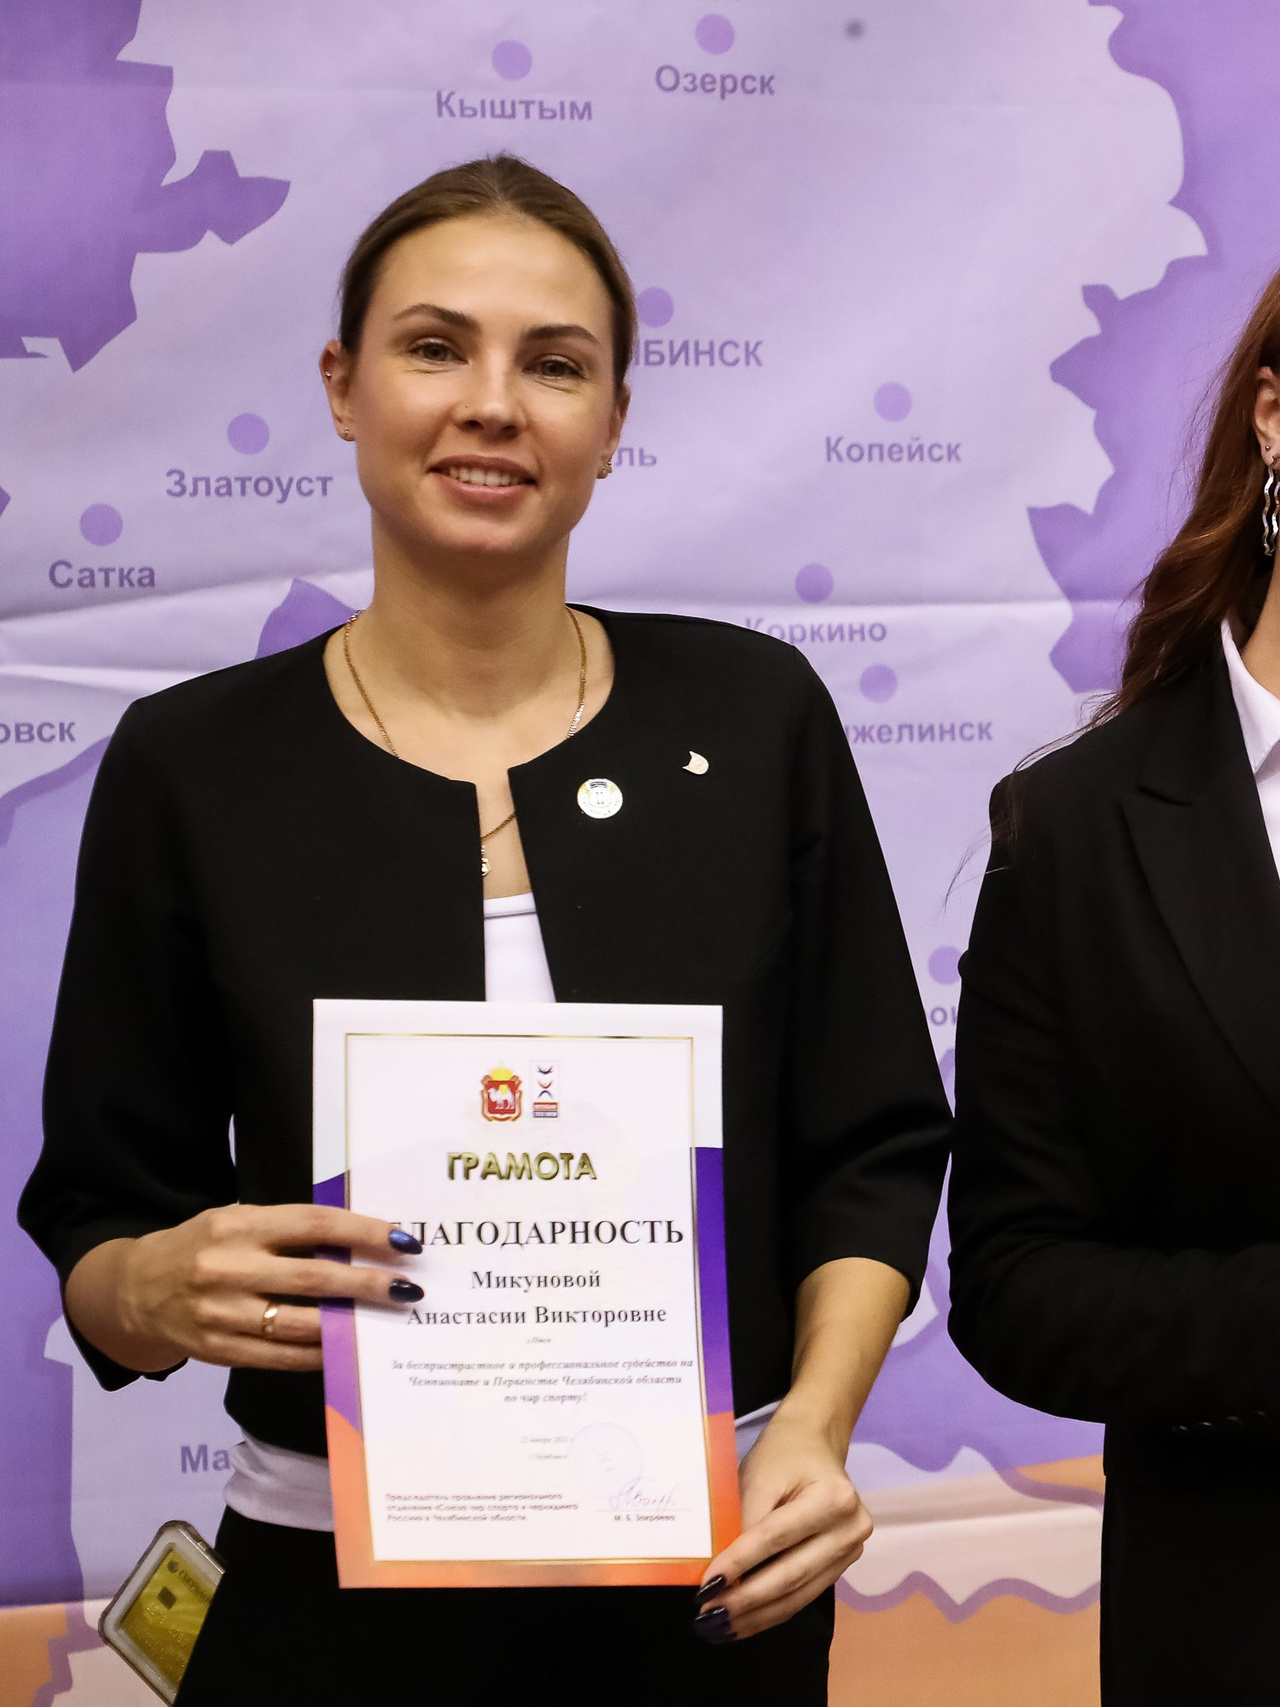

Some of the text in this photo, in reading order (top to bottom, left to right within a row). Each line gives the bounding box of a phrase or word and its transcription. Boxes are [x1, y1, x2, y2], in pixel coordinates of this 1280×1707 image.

[655, 64, 775, 100] Озерск
[436, 90, 593, 121] Кыштым
[634, 339, 763, 367] БИНСК
[825, 435, 961, 463] Копейск
[165, 468, 334, 504] Златоуст
[48, 559, 156, 588] Сатка
[845, 721, 993, 744] желинск
[446, 1152, 597, 1181] ГРАМОТА
[390, 1220, 685, 1249] ЛАГОДАРНОСТЬ
[471, 1269, 601, 1293] Микуновой
[407, 1306, 666, 1328] Анастасии Викторовне
